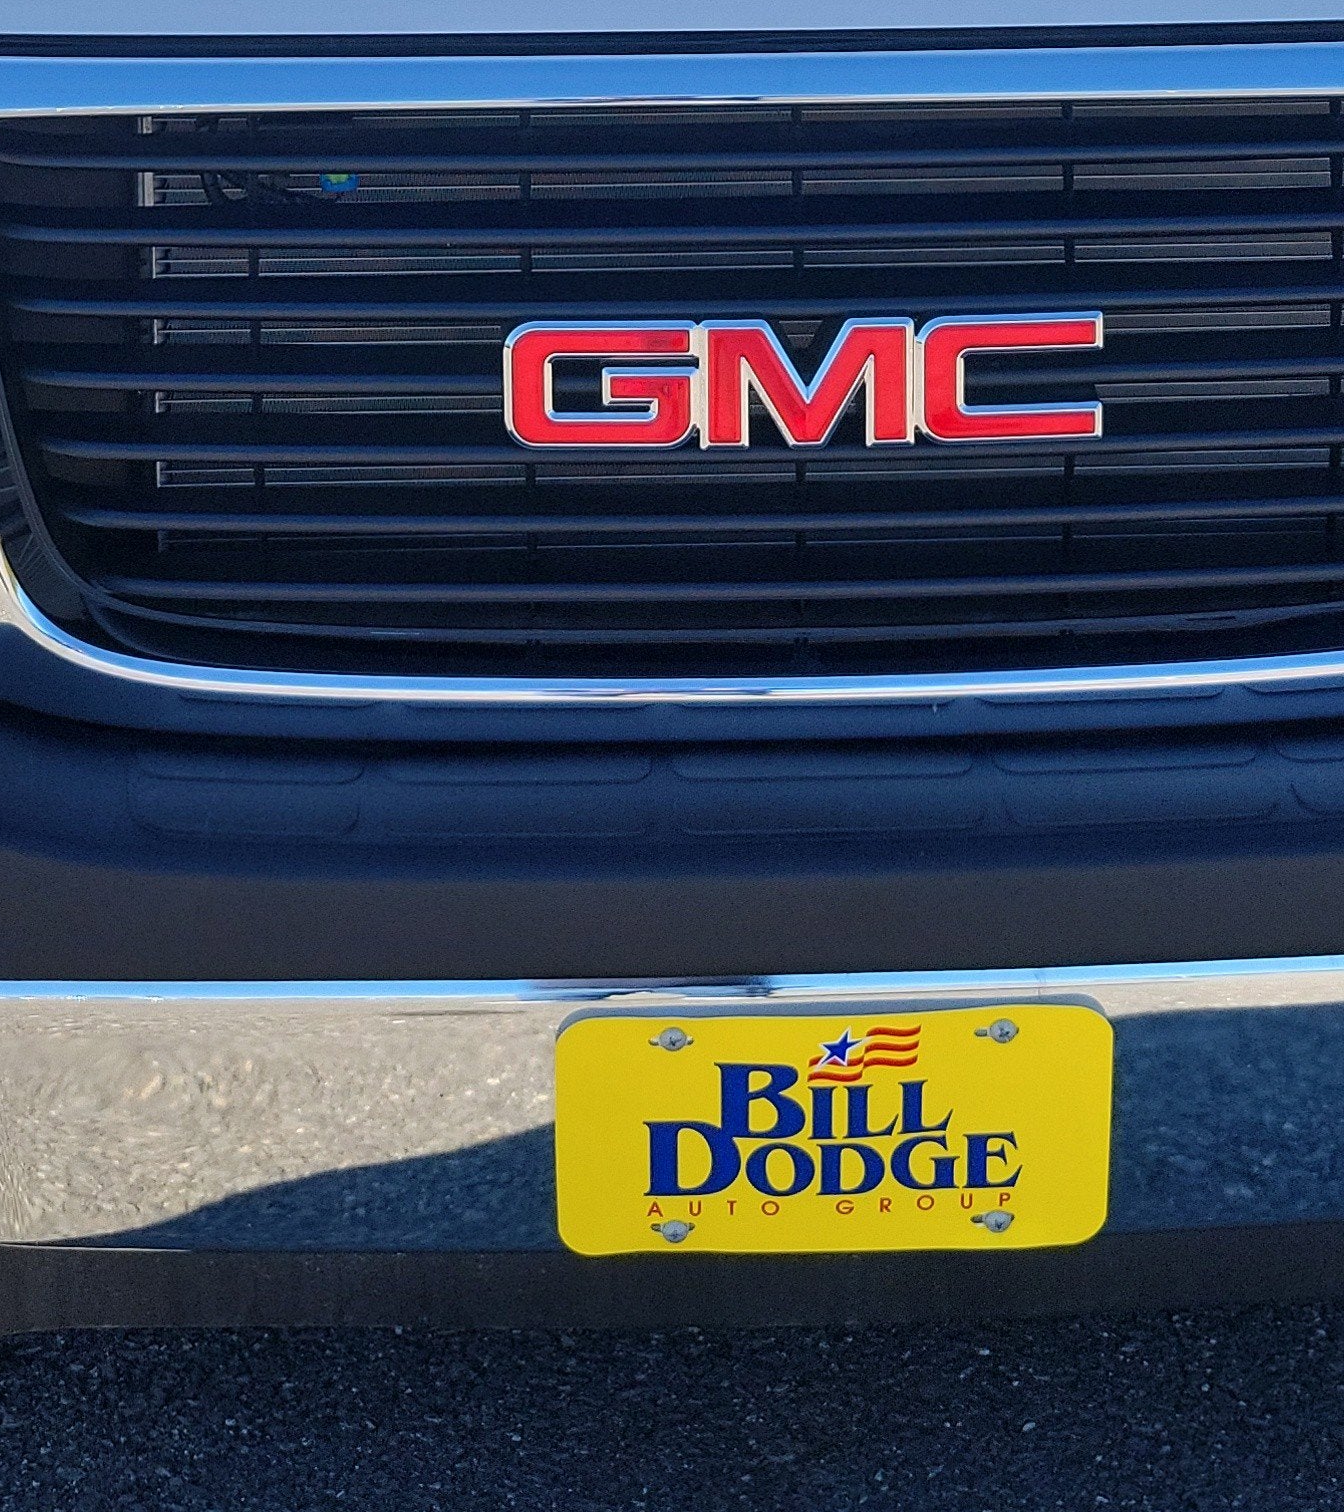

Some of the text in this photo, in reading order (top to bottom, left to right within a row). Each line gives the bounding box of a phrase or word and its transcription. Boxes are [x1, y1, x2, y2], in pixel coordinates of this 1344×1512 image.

[503, 311, 1104, 450] GMC
[713, 1061, 954, 1141] BILL
[642, 1120, 1023, 1198] DODGE
[646, 1191, 1013, 1219] AUTO GROUP
